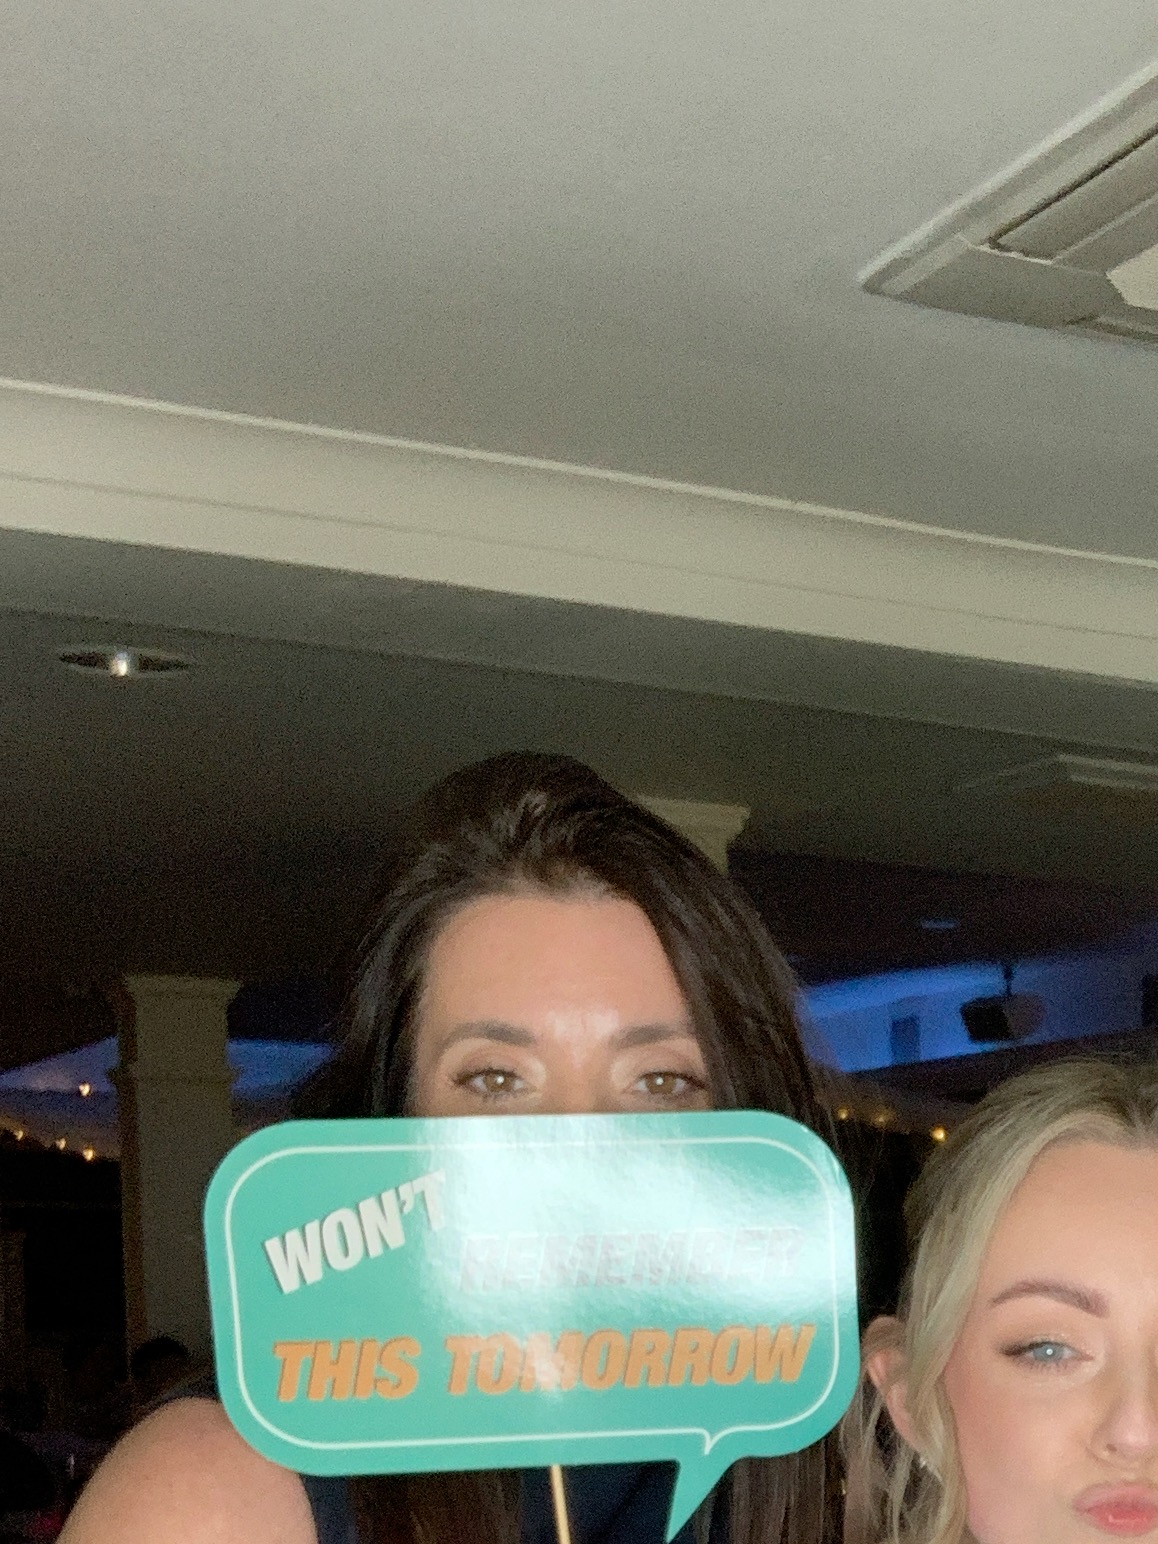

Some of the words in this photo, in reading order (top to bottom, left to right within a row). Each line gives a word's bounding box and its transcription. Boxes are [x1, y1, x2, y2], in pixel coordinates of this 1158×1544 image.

[262, 1169, 446, 1295] WON'T
[273, 1335, 421, 1402] THIS
[445, 1323, 817, 1395] TOMORROW
